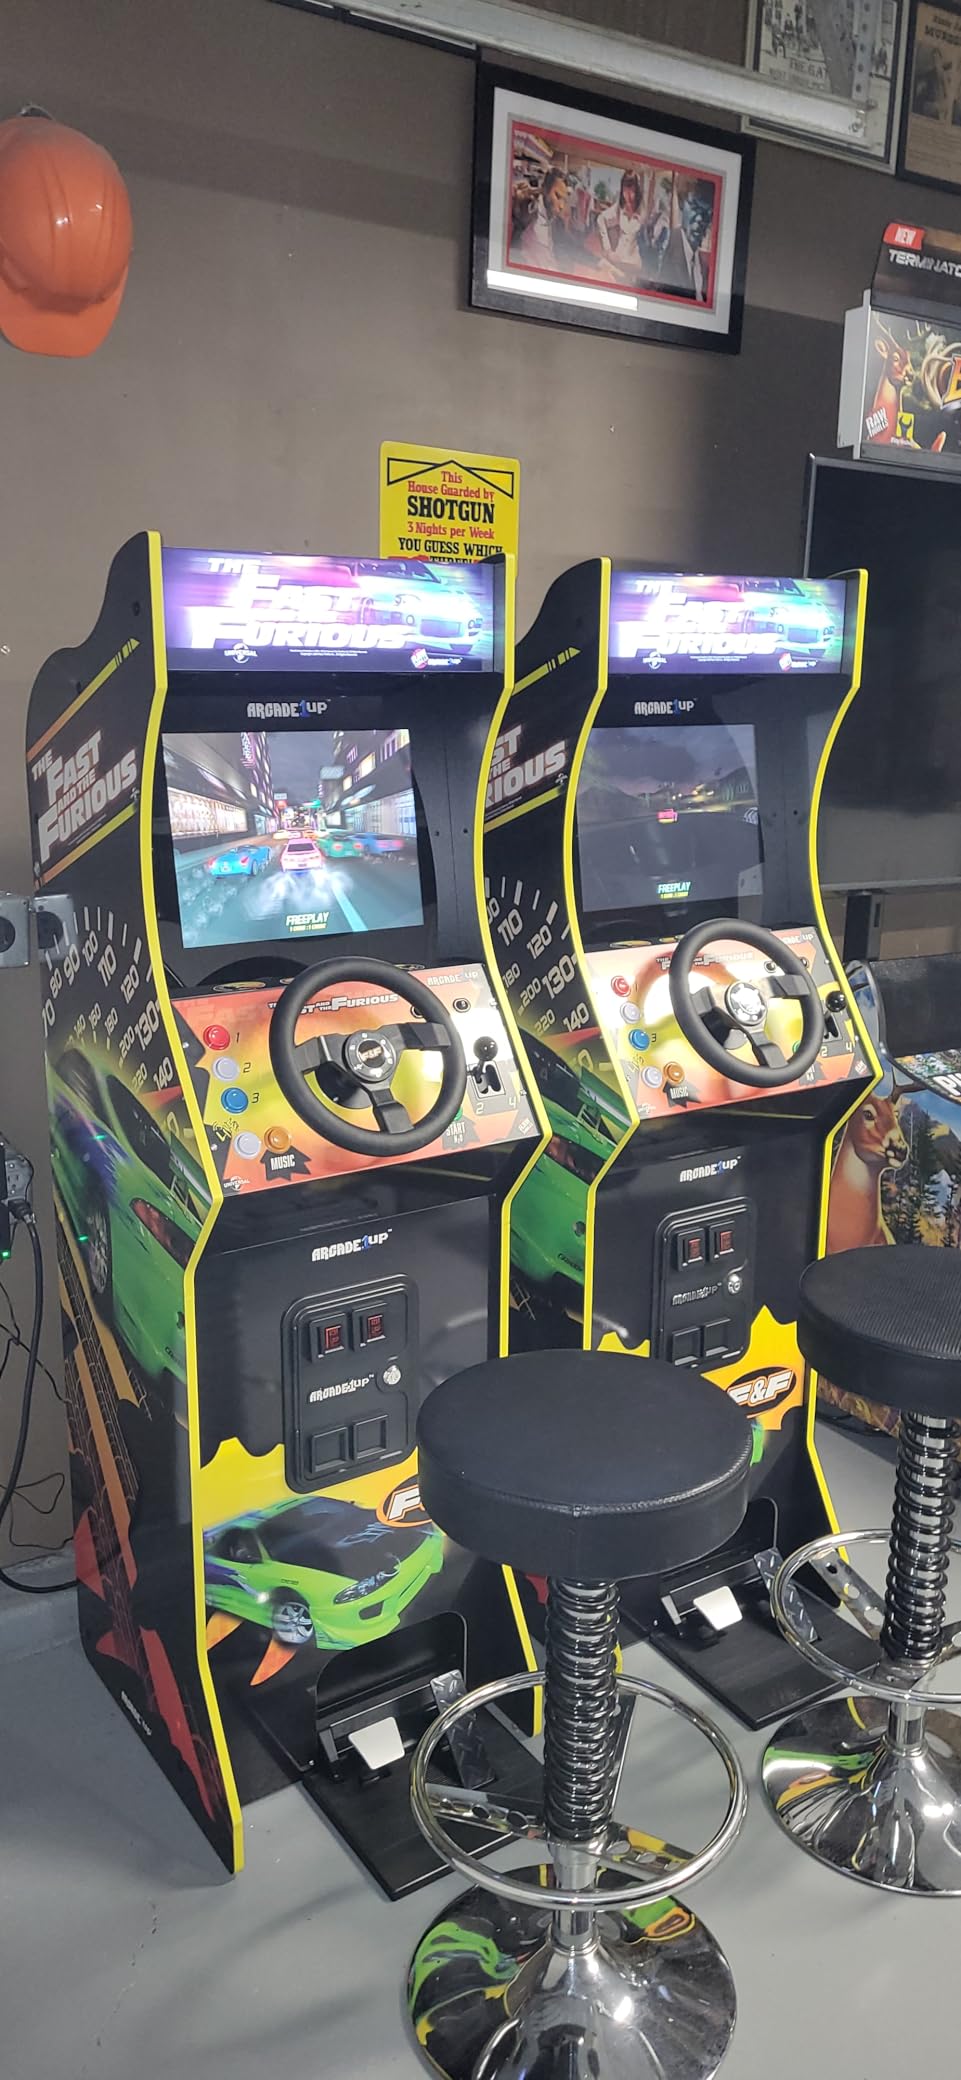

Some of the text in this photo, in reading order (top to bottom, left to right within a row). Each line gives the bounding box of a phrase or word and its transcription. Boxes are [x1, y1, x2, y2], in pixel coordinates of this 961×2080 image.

[895, 227, 916, 245] NEW
[865, 407, 887, 436] RAW
[408, 480, 495, 502] House Guarded by
[441, 471, 463, 483] This
[407, 495, 495, 524] SHOTGUN
[407, 521, 495, 539] 3 Nights per Week
[398, 537, 422, 552] YOU
[424, 539, 460, 554] GUESS
[188, 606, 415, 649] FURIOUS
[491, 724, 522, 766] ST
[31, 749, 54, 782] THE
[45, 729, 102, 805] FAST
[485, 740, 566, 809] RIOUS
[56, 767, 96, 812] AND THE
[37, 749, 137, 865] FURIOUS
[658, 881, 691, 894] FREEPLAY
[286, 911, 329, 927] FREEPLAY
[497, 908, 523, 946] 110
[81, 930, 98, 967] 100
[526, 924, 552, 960] 120
[63, 943, 80, 986] 90
[98, 944, 117, 987] 110
[502, 962, 521, 989] 180
[541, 954, 576, 1000] 130
[50, 967, 62, 999] 80
[120, 964, 140, 1004] 120
[519, 977, 541, 1007] 200
[331, 994, 400, 1011] FURIOUS
[562, 1002, 590, 1032] 140
[104, 1008, 118, 1035] 180
[134, 1000, 160, 1051] 130
[534, 1008, 556, 1036] 220
[119, 1025, 135, 1059] 200
[651, 1033, 657, 1042] 3
[821, 1042, 853, 1057] 2 4
[153, 1056, 174, 1091] 140
[242, 1062, 252, 1073] 2
[251, 1092, 260, 1103] 3
[476, 1096, 517, 1115] 2 4
[670, 1086, 689, 1099] MUSIC
[446, 1121, 466, 1137] START
[270, 1154, 295, 1171] MUSIC
